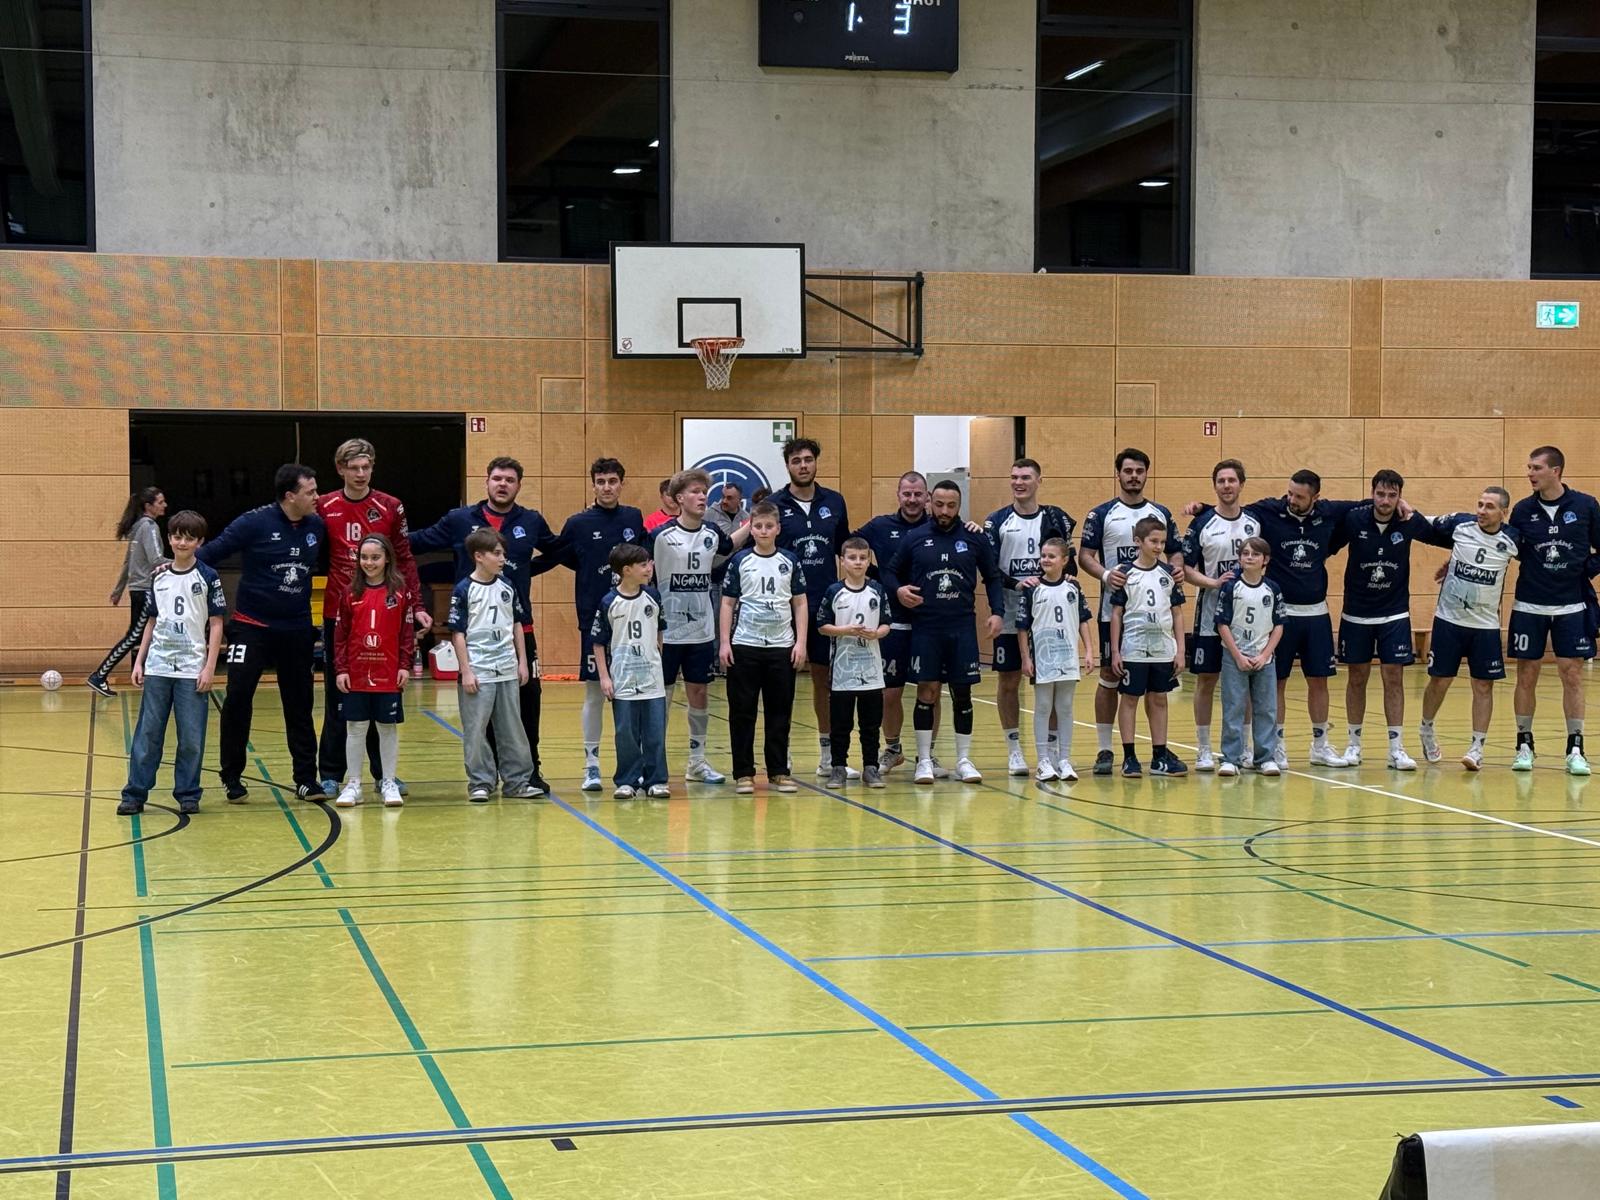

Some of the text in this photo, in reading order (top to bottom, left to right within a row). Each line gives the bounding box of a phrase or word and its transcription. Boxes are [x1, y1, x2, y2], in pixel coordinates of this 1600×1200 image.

[893, 3, 911, 35] 3
[346, 523, 361, 541] 18
[1299, 526, 1304, 535] 7
[1548, 525, 1559, 534] 20
[289, 547, 300, 557] 33
[1027, 537, 1035, 555] 8
[1377, 547, 1384, 556] 2
[687, 551, 701, 570] 15
[1474, 547, 1487, 564] 6
[761, 576, 776, 595] 14
[174, 595, 185, 616] 6
[1146, 589, 1156, 607] 3
[370, 609, 376, 629] 1
[489, 605, 498, 625] 7
[1054, 605, 1064, 623] 8
[1245, 606, 1256, 624] 5
[628, 620, 642, 640] 19
[226, 644, 247, 663] 33
[996, 646, 1005, 664] 8
[1194, 647, 1205, 665] 19
[587, 654, 596, 673] 5
[1122, 669, 1130, 686] 3
